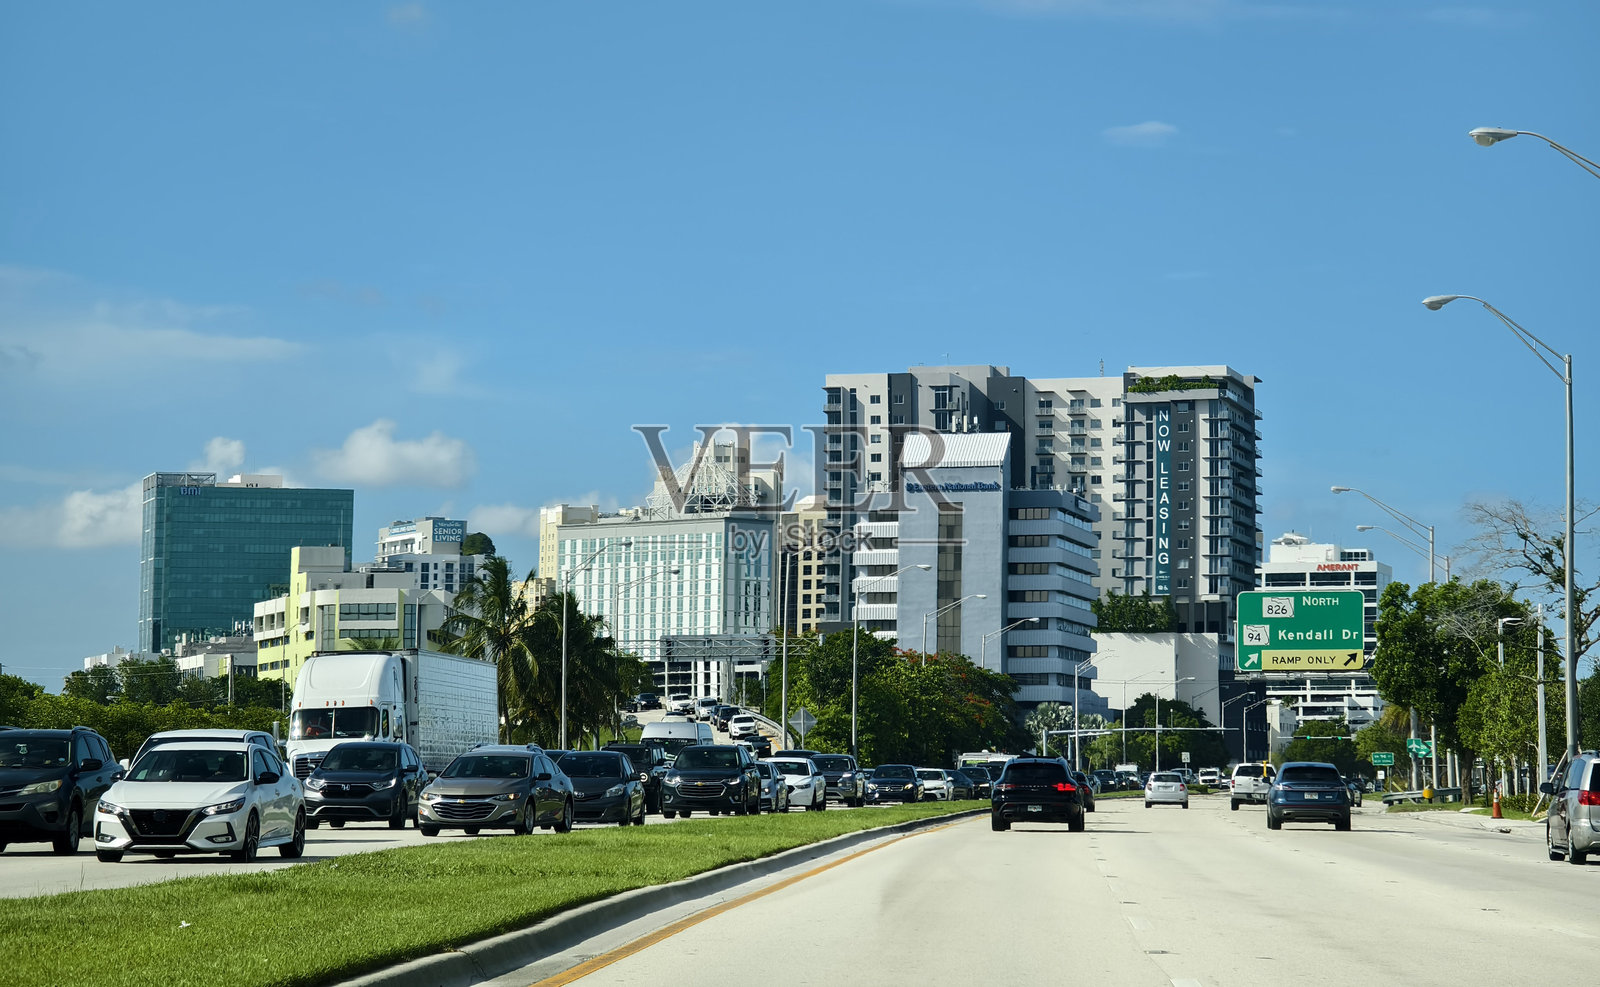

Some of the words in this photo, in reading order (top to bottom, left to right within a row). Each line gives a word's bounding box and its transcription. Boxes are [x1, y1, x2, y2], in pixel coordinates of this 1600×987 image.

[1158, 410, 1171, 452] NOW
[913, 482, 943, 492] Eastern
[944, 481, 976, 492] National
[978, 481, 1000, 492] Bank
[1157, 462, 1170, 565] LEASING
[1316, 563, 1359, 571] AMERANT
[1302, 596, 1339, 606] NORTH
[1267, 604, 1287, 615] 826
[1247, 632, 1261, 642] 94
[1278, 629, 1333, 641] Kendall
[1342, 629, 1359, 640] Dr
[1272, 656, 1302, 664] RAMP
[1307, 656, 1336, 664] ONLY
